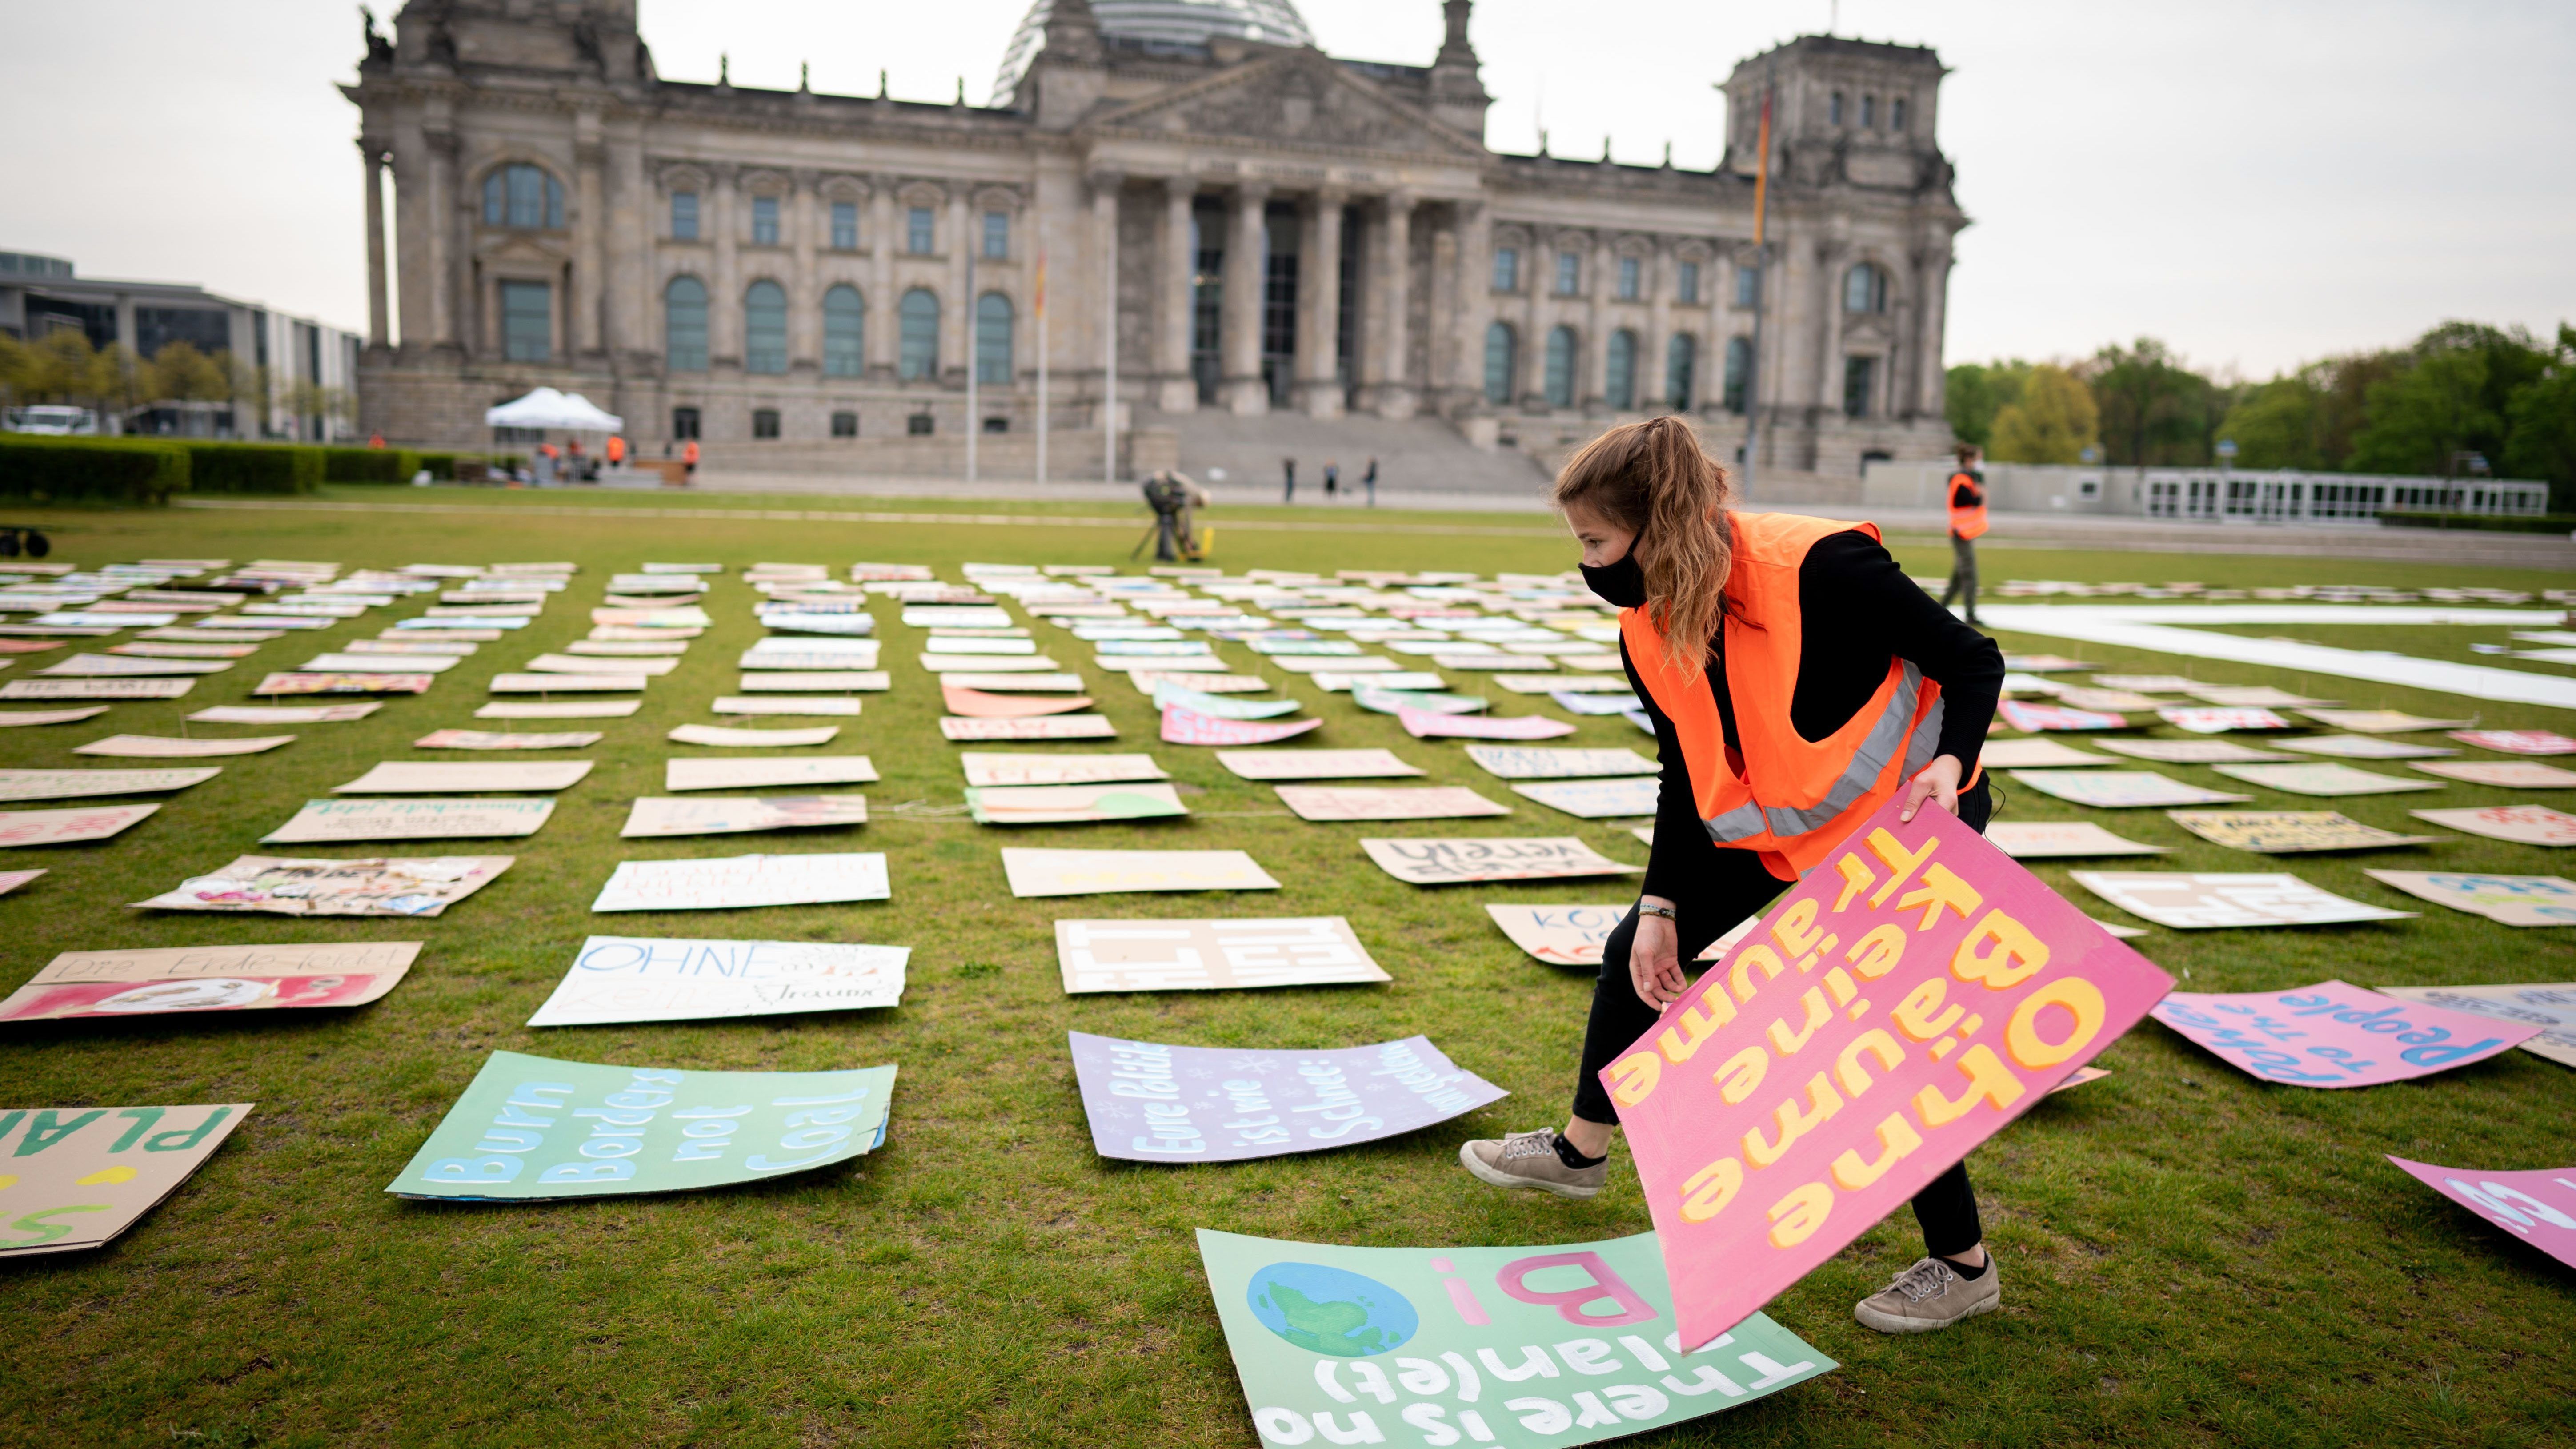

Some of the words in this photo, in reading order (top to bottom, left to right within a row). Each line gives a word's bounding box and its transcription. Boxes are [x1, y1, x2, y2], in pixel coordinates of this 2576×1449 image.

[56, 957, 135, 979] Die
[169, 951, 277, 975] Erde
[580, 943, 787, 978] OHNE
[1608, 827, 1940, 1108] Träume
[1713, 862, 1983, 1105] keine
[2278, 994, 2505, 1067] People
[1108, 1041, 1181, 1100] Politik
[1206, 1079, 1274, 1113] wie
[1679, 908, 2051, 1224] Bäume
[421, 1081, 575, 1184] Burn
[537, 1068, 685, 1184] Borders
[671, 1105, 753, 1162] not
[745, 1087, 869, 1171] Coal
[1132, 1103, 1206, 1153] Eure
[1223, 1114, 1290, 1146] ist
[1768, 976, 2106, 1250] Ohne
[1253, 1405, 1385, 1445] no
[1401, 1403, 1507, 1449] is
[1504, 1350, 1817, 1437] There
